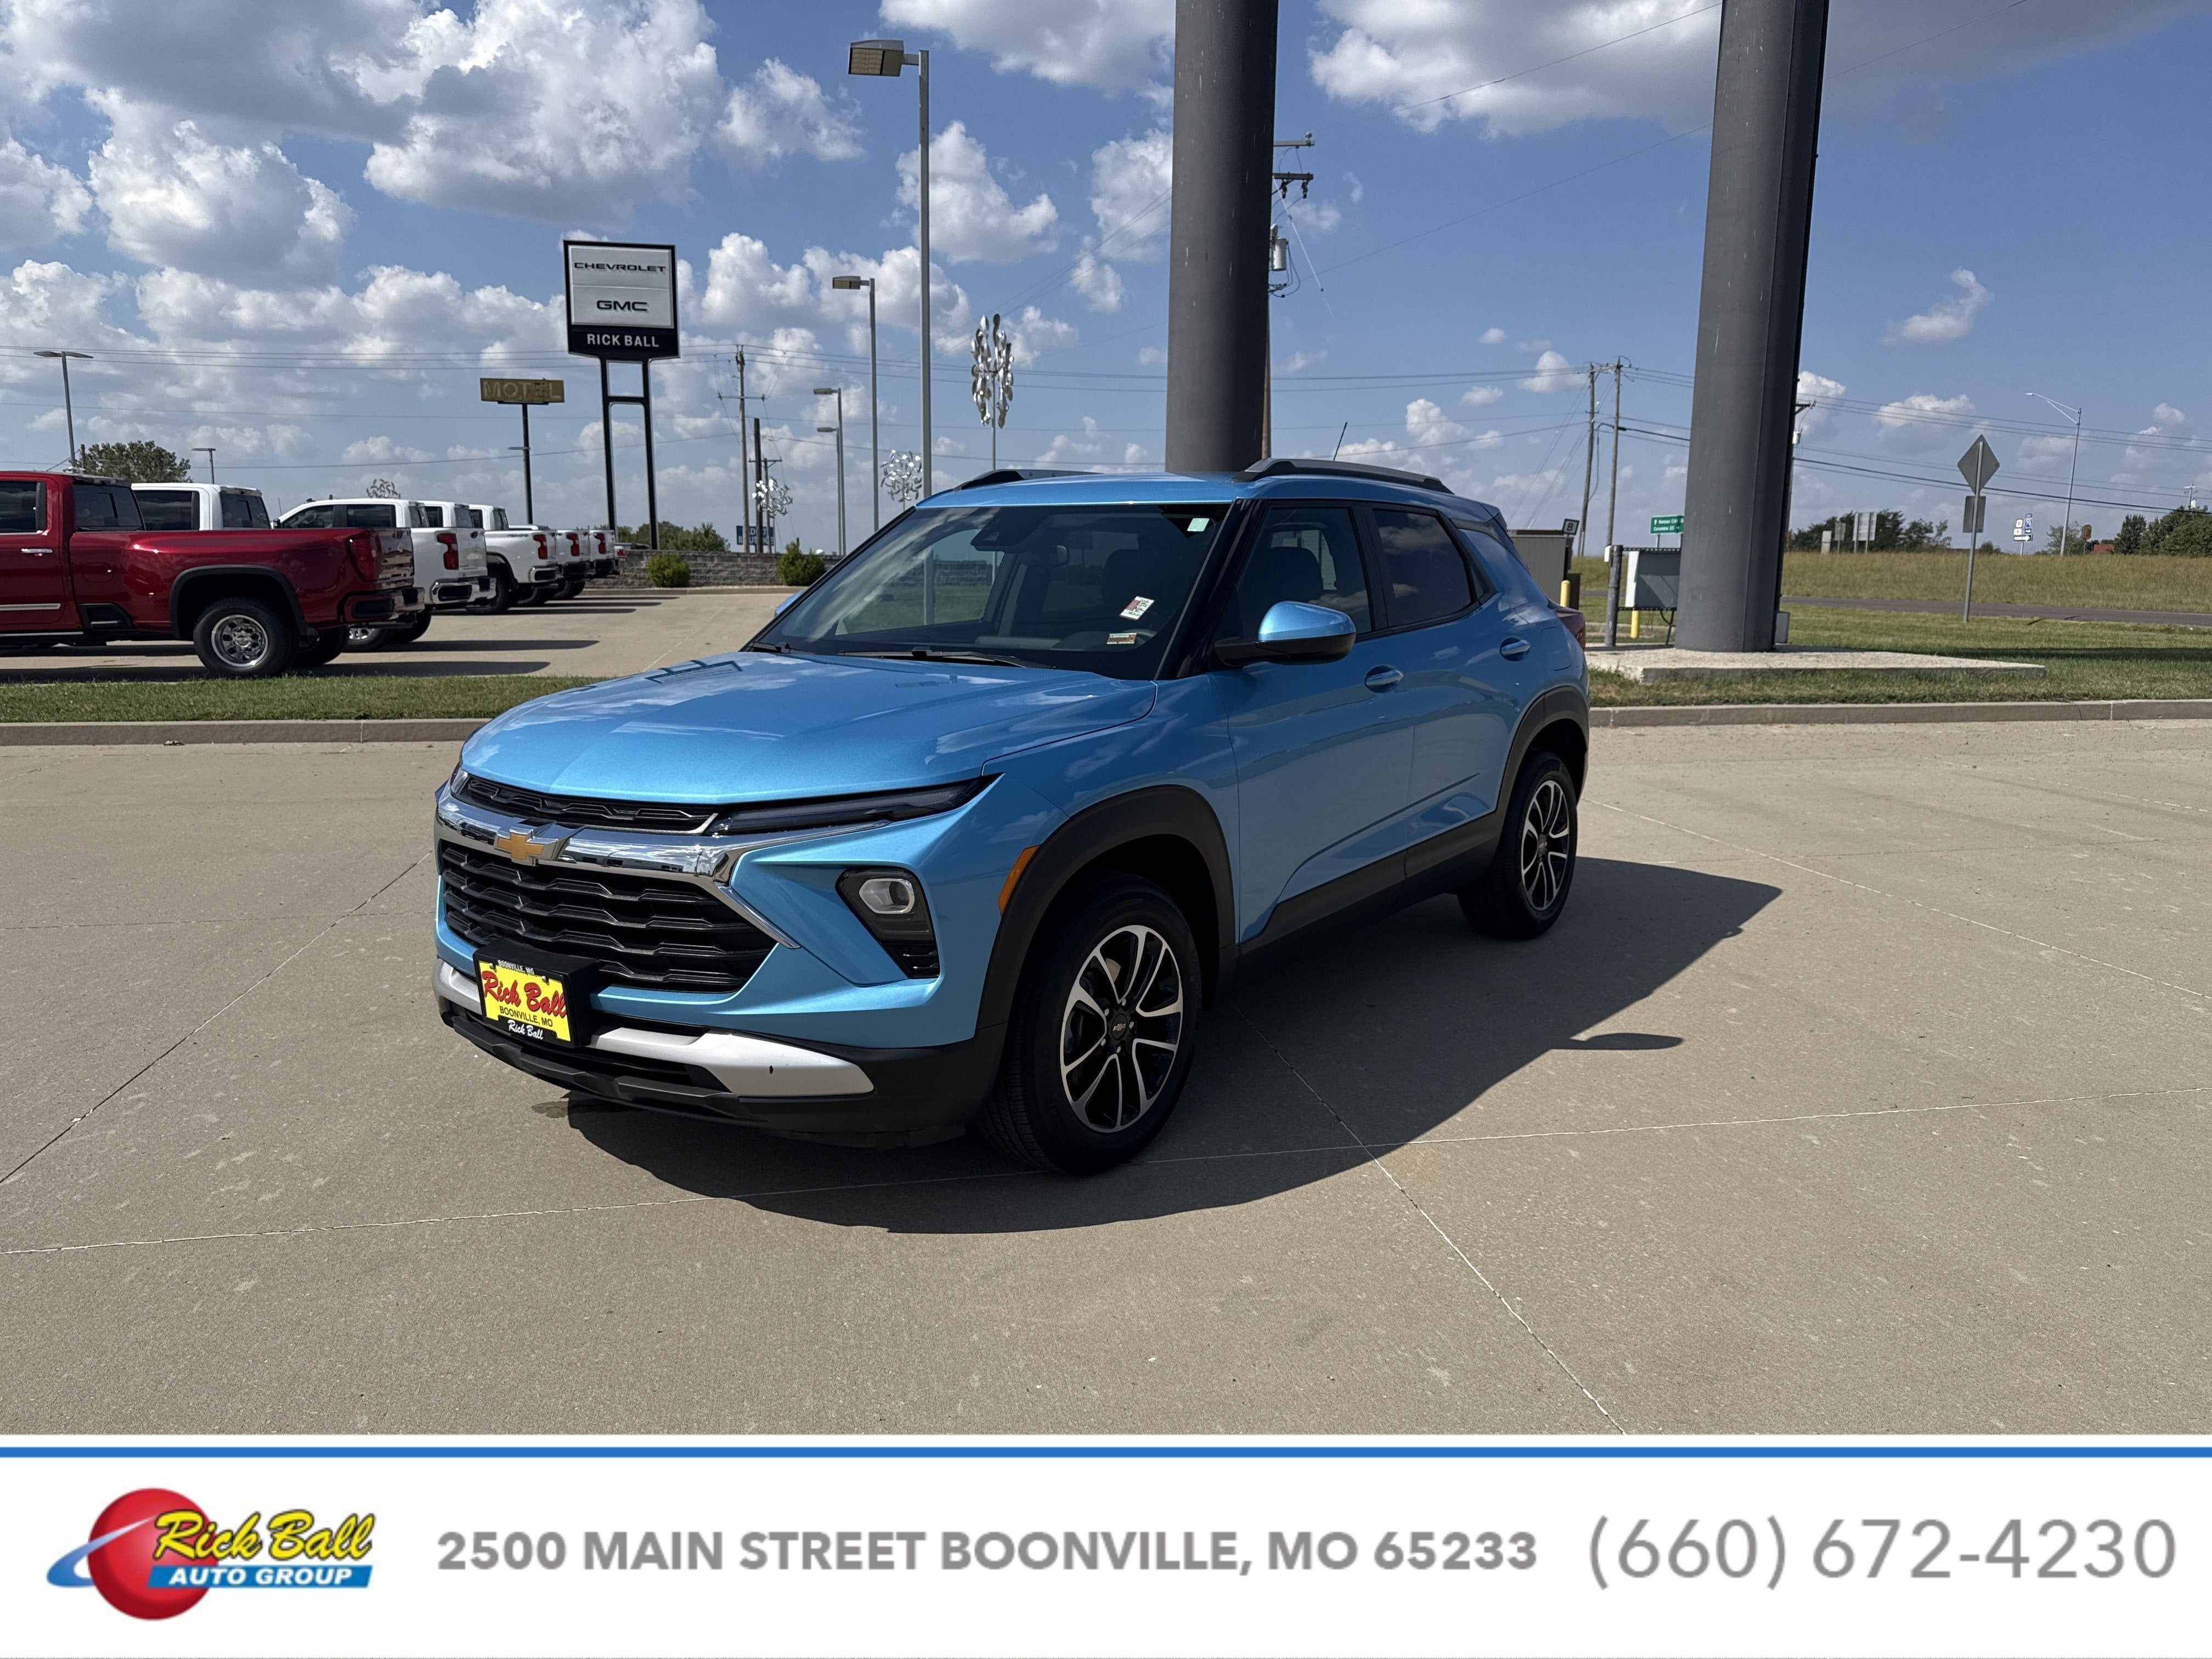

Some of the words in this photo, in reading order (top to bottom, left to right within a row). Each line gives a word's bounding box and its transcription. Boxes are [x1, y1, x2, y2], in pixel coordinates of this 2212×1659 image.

[574, 262, 666, 273] CHEVROLET
[596, 300, 648, 312] GMC
[586, 334, 621, 346] RICK
[624, 335, 659, 347] BALL
[482, 970, 522, 1007] Rick
[523, 982, 567, 1019] Ball
[499, 1006, 540, 1025] BOONVILLE,
[541, 1016, 553, 1027] MO
[507, 1019, 527, 1035] Rick
[526, 1024, 544, 1040] Ball
